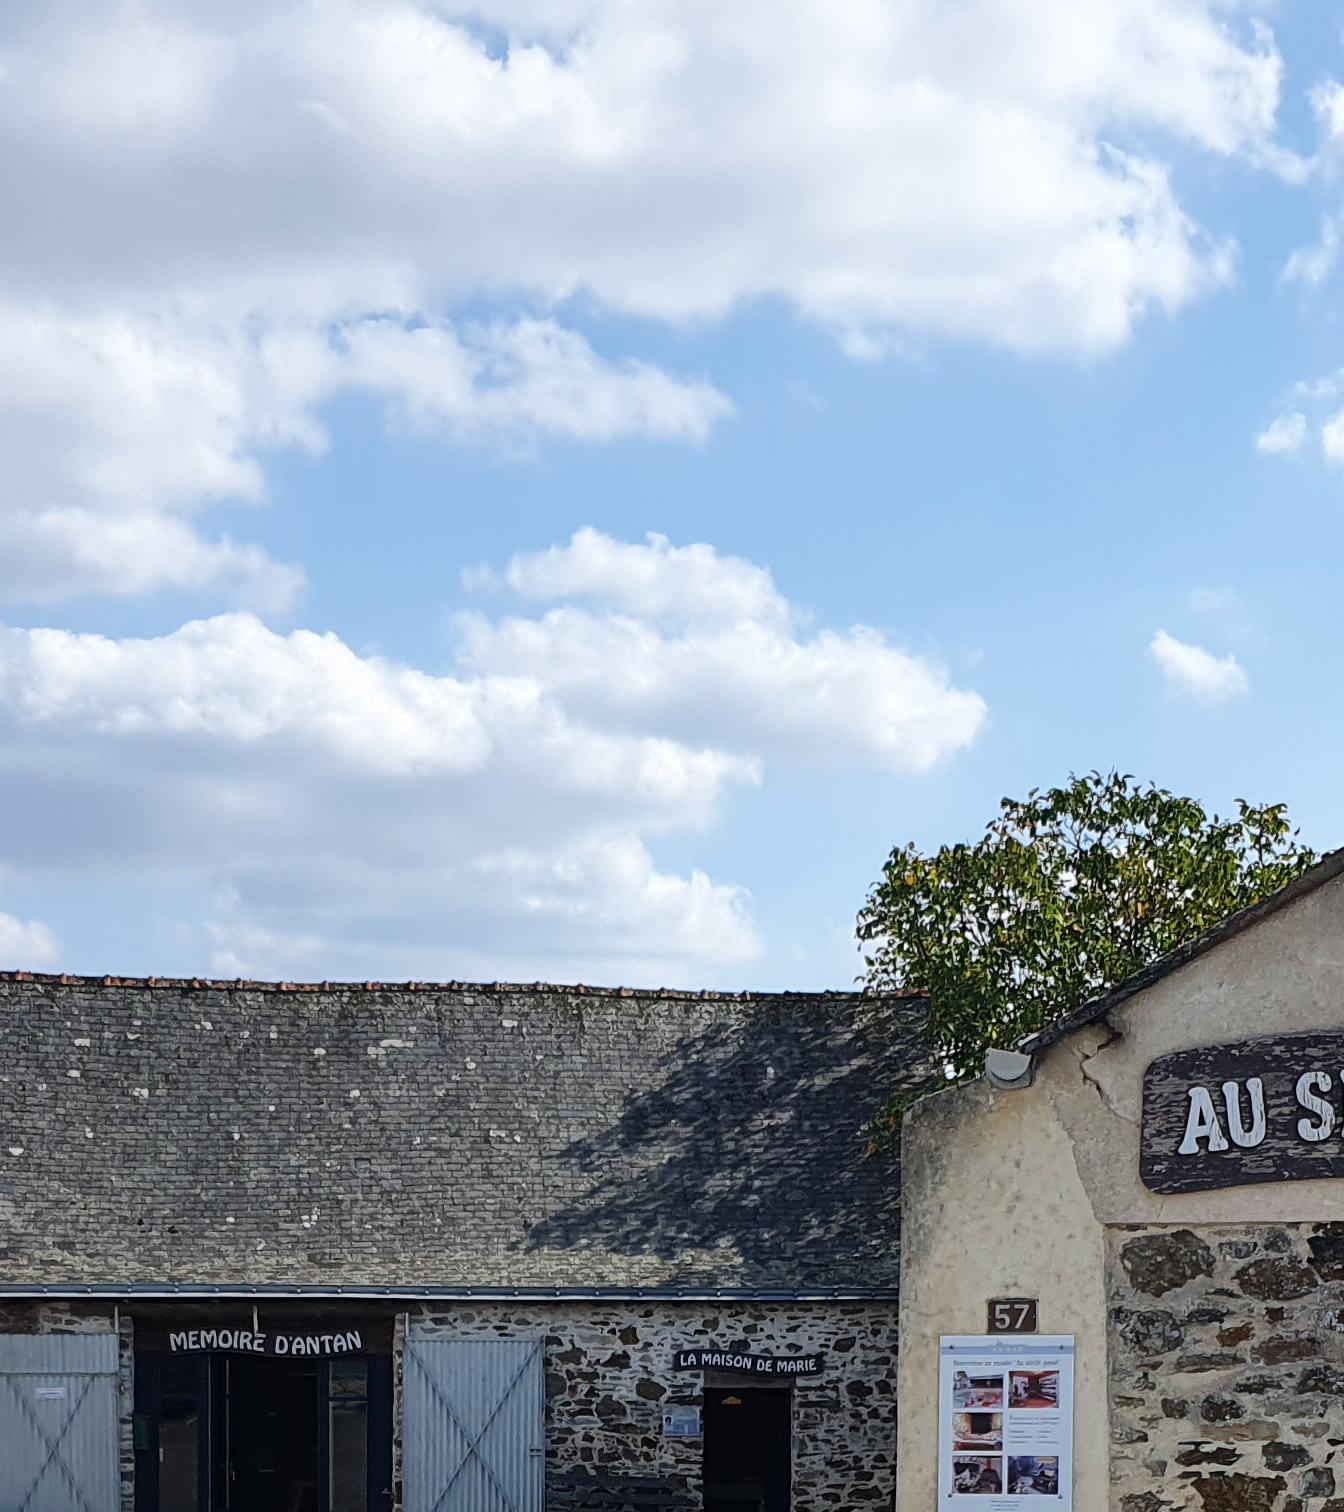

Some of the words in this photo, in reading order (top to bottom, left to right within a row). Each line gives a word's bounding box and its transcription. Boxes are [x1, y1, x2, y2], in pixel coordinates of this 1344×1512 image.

[1177, 1078, 1265, 1155] AU
[995, 1304, 1030, 1329] 57
[169, 1330, 267, 1351] MEMOIRE
[275, 1330, 362, 1355] D'ANTAN
[680, 1353, 697, 1367] LA
[701, 1353, 752, 1370] MAISON
[756, 1359, 773, 1372] DE
[776, 1358, 817, 1373] MARIE
